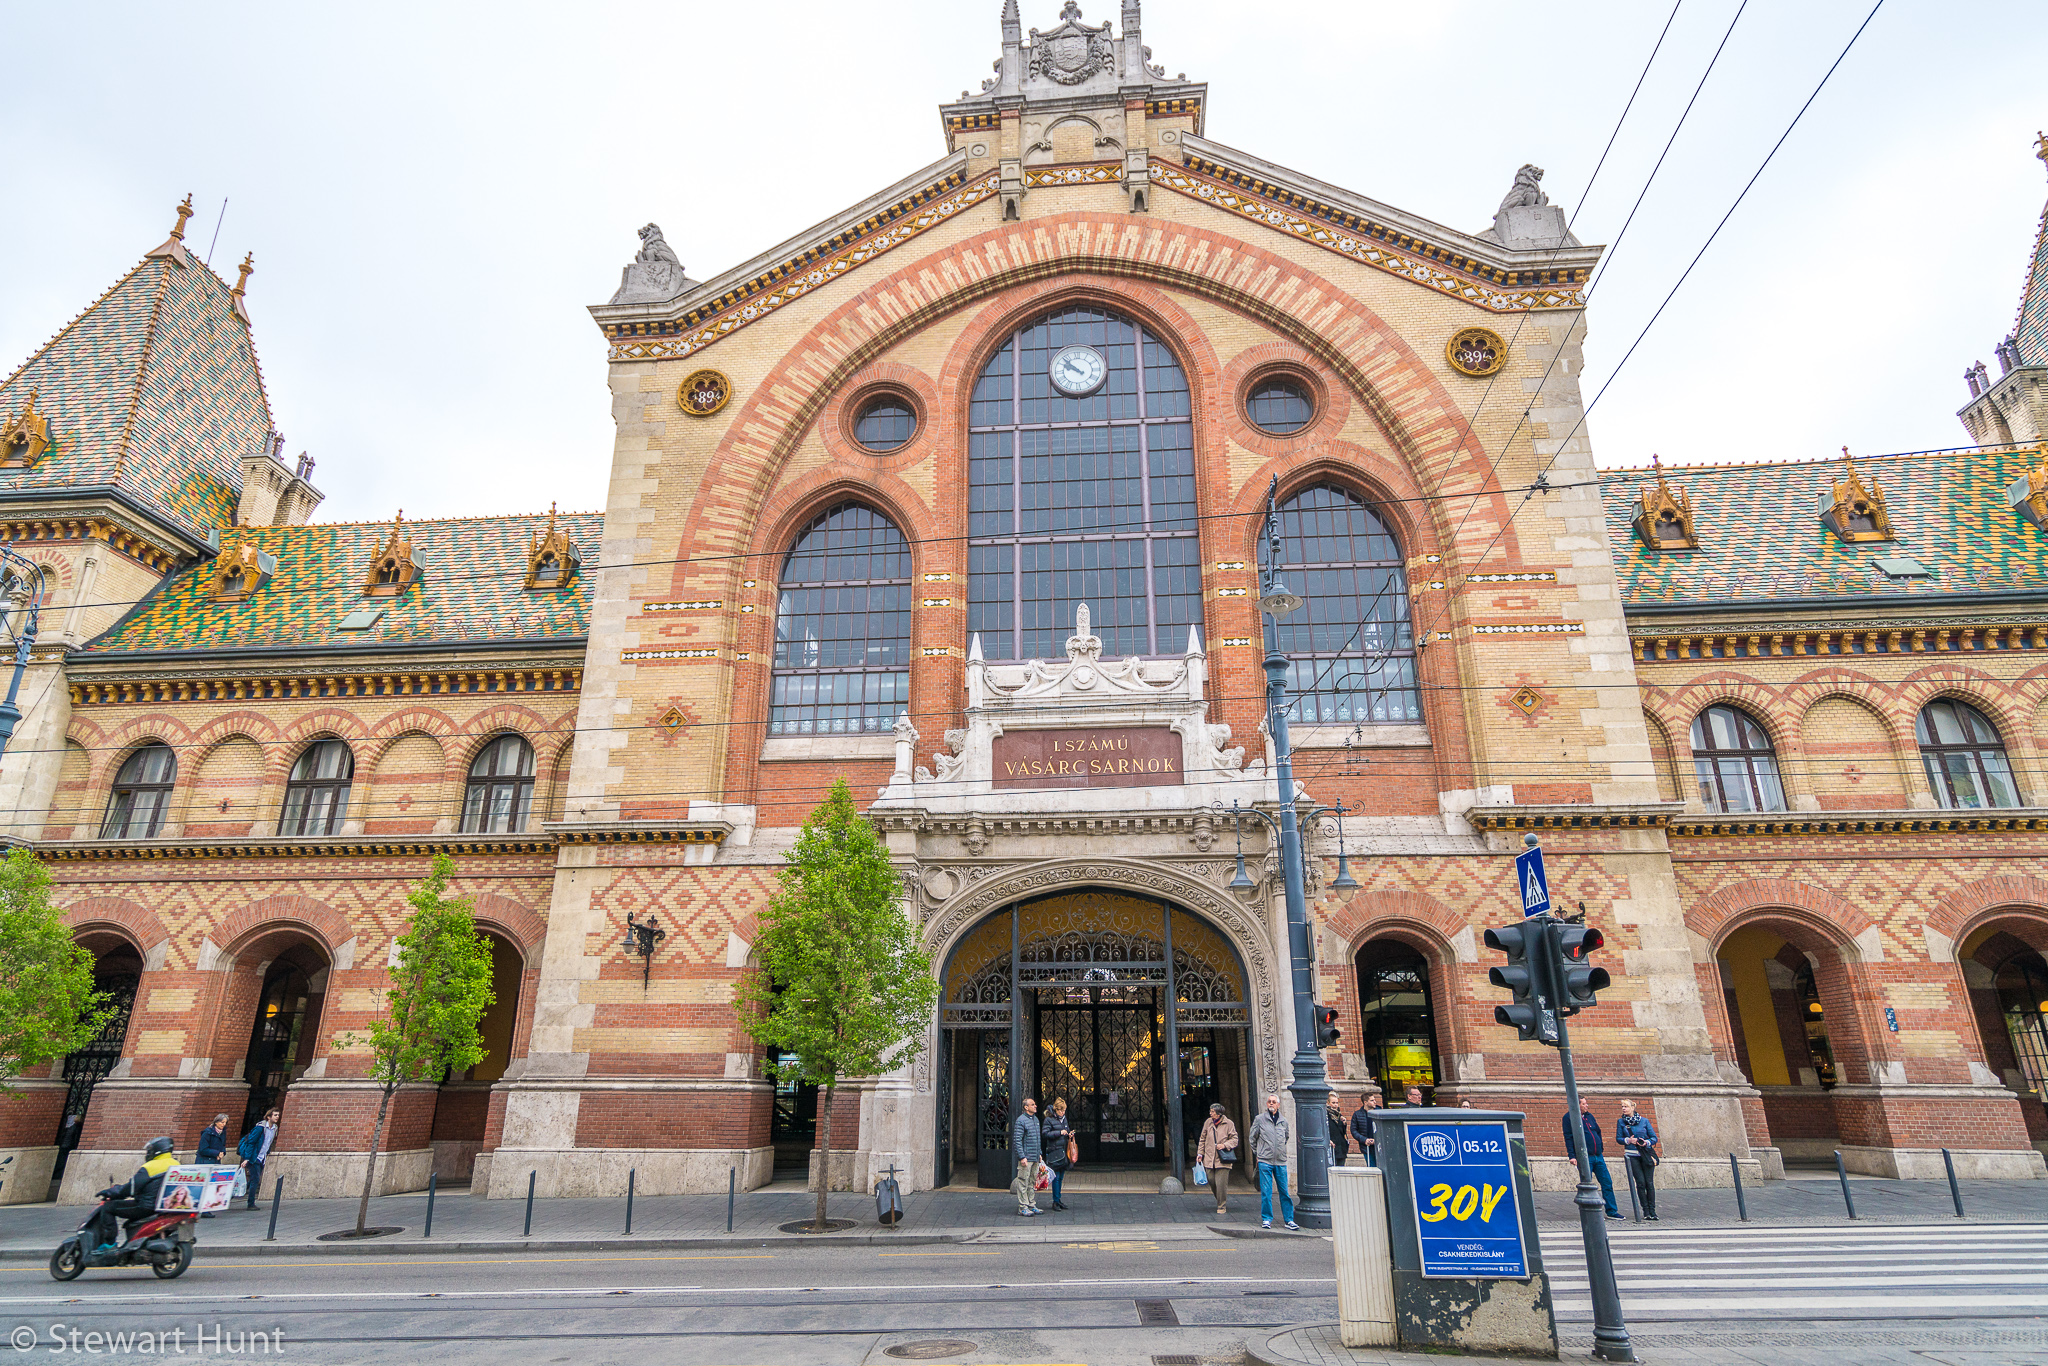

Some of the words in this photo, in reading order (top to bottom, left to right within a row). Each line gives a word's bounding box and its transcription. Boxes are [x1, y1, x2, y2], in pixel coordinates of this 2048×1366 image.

[1065, 734, 1129, 752] SZÁMÚ
[1004, 755, 1176, 776] VÁSÁRCSARNOK
[1420, 1135, 1446, 1146] BUDAPEST
[1462, 1140, 1502, 1153] 05.12.
[1421, 1144, 1447, 1157] PARK
[1420, 1182, 1508, 1224] 30Y
[1456, 1243, 1485, 1251] VENDÉG:
[1438, 1250, 1505, 1258] CSAKNEKEDKISLÁNY
